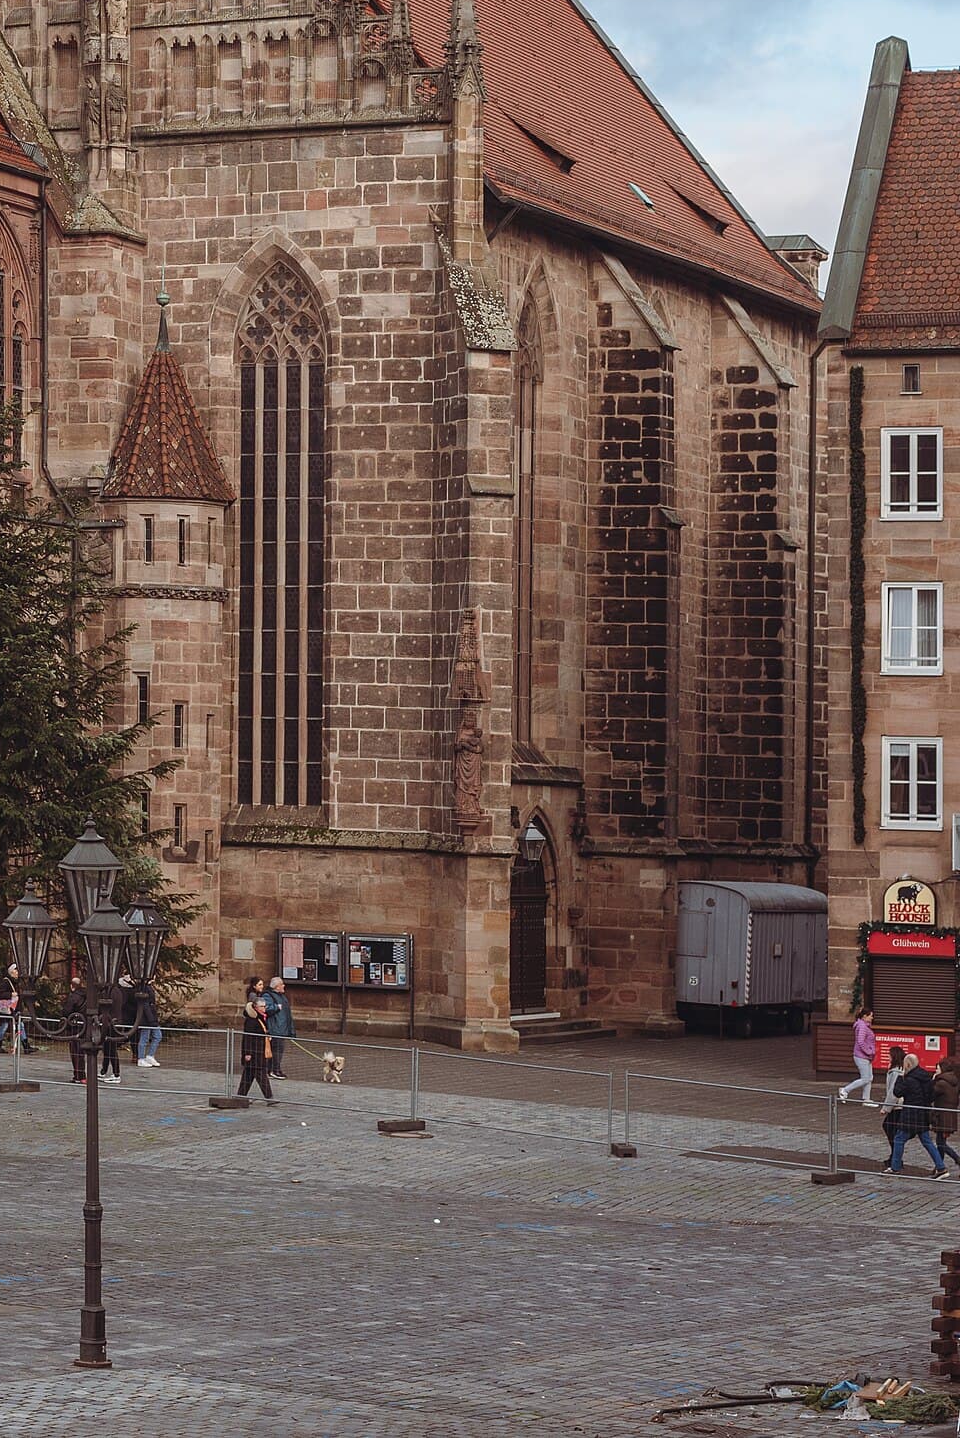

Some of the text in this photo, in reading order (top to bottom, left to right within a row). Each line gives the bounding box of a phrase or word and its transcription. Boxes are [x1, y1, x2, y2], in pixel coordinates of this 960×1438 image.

[888, 903, 930, 913] BLOCK
[888, 912, 930, 923] HOUSE
[892, 938, 930, 948] Glühwein
